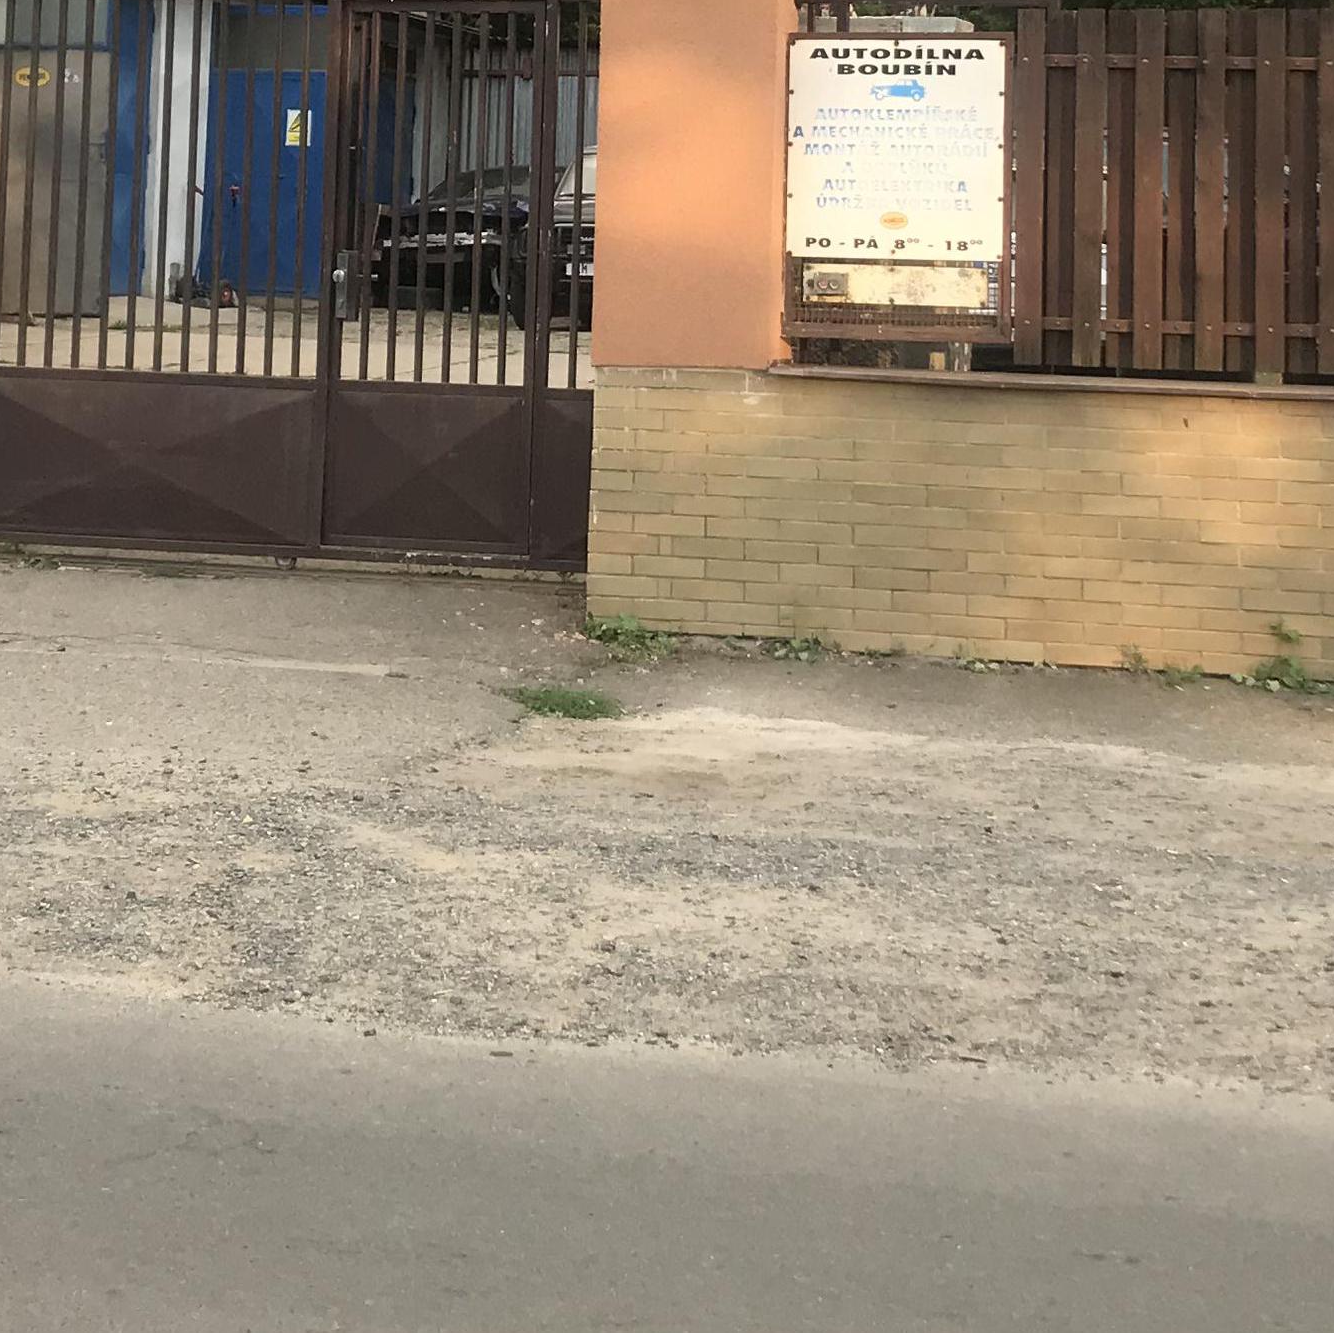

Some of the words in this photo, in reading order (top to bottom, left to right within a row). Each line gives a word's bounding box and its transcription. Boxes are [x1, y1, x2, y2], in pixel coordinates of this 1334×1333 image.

[810, 45, 985, 60] AUTODÍLNA
[837, 61, 956, 75] BOUBÍN
[793, 126, 804, 138] A
[816, 193, 888, 210] ÚDRŽ
[805, 237, 831, 248] PO
[854, 236, 879, 250] PÁ
